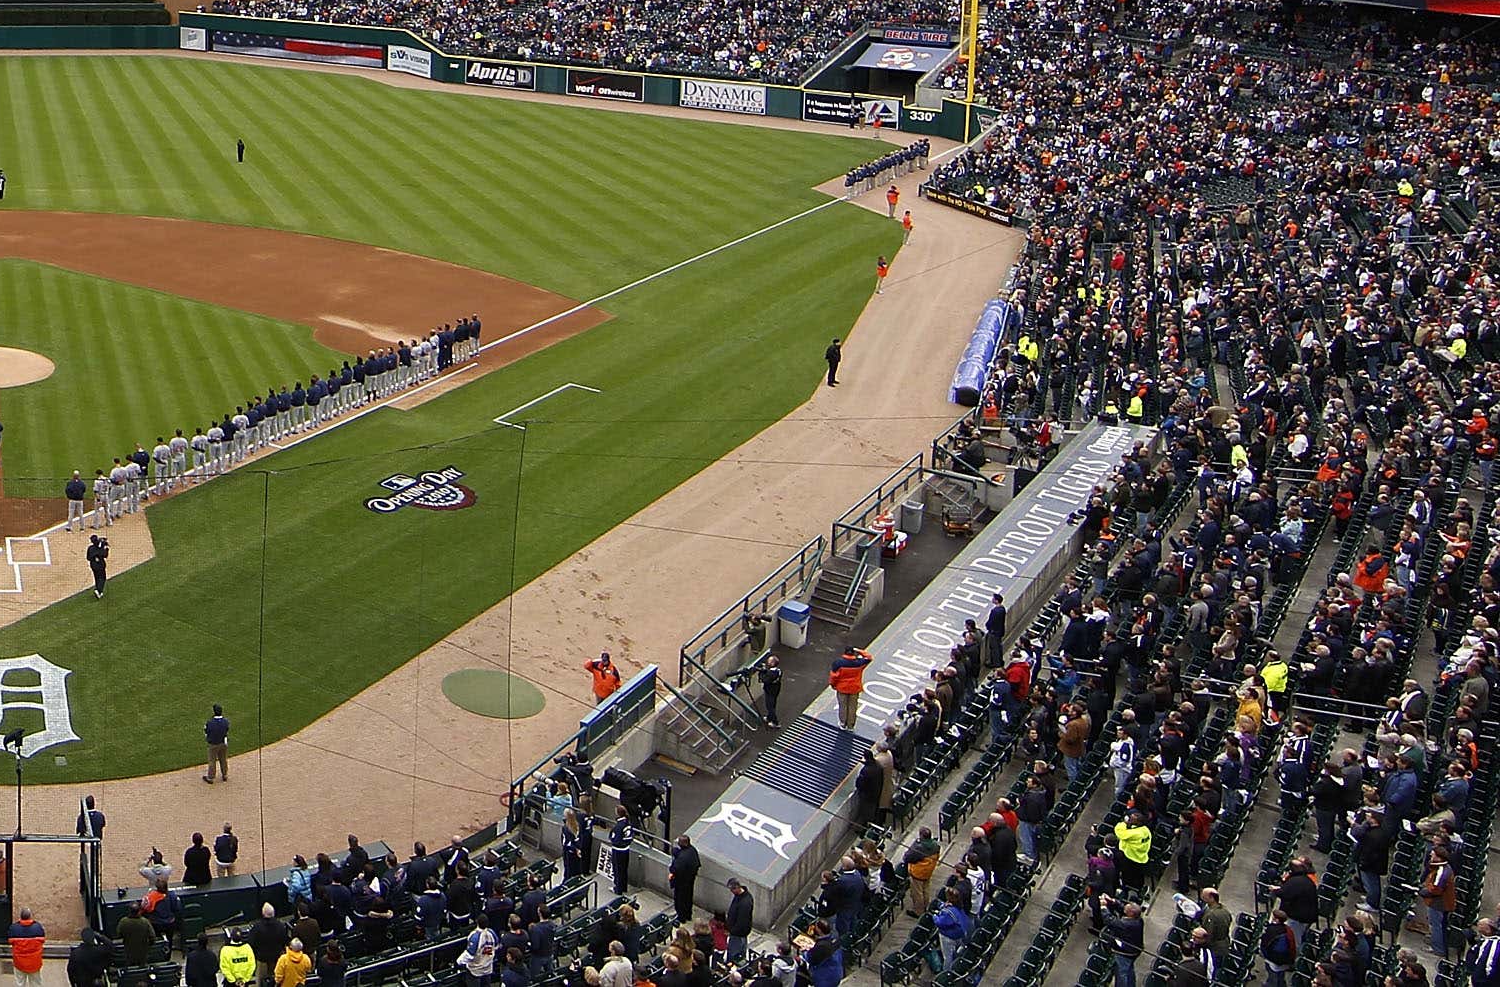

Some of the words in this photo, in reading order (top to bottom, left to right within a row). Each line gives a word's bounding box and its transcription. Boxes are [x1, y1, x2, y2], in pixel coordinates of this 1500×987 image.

[885, 29, 918, 40] BELLE
[921, 32, 948, 42] TIRE
[468, 63, 508, 80] April
[683, 81, 763, 103] DYNAMIC
[367, 482, 435, 511] OPENING
[421, 467, 463, 485] DAY
[1037, 456, 1111, 512] TIGERS
[975, 500, 1068, 580] DETROIT
[938, 574, 1002, 628] THE
[913, 617, 965, 662] OF
[855, 647, 938, 728] HOME
